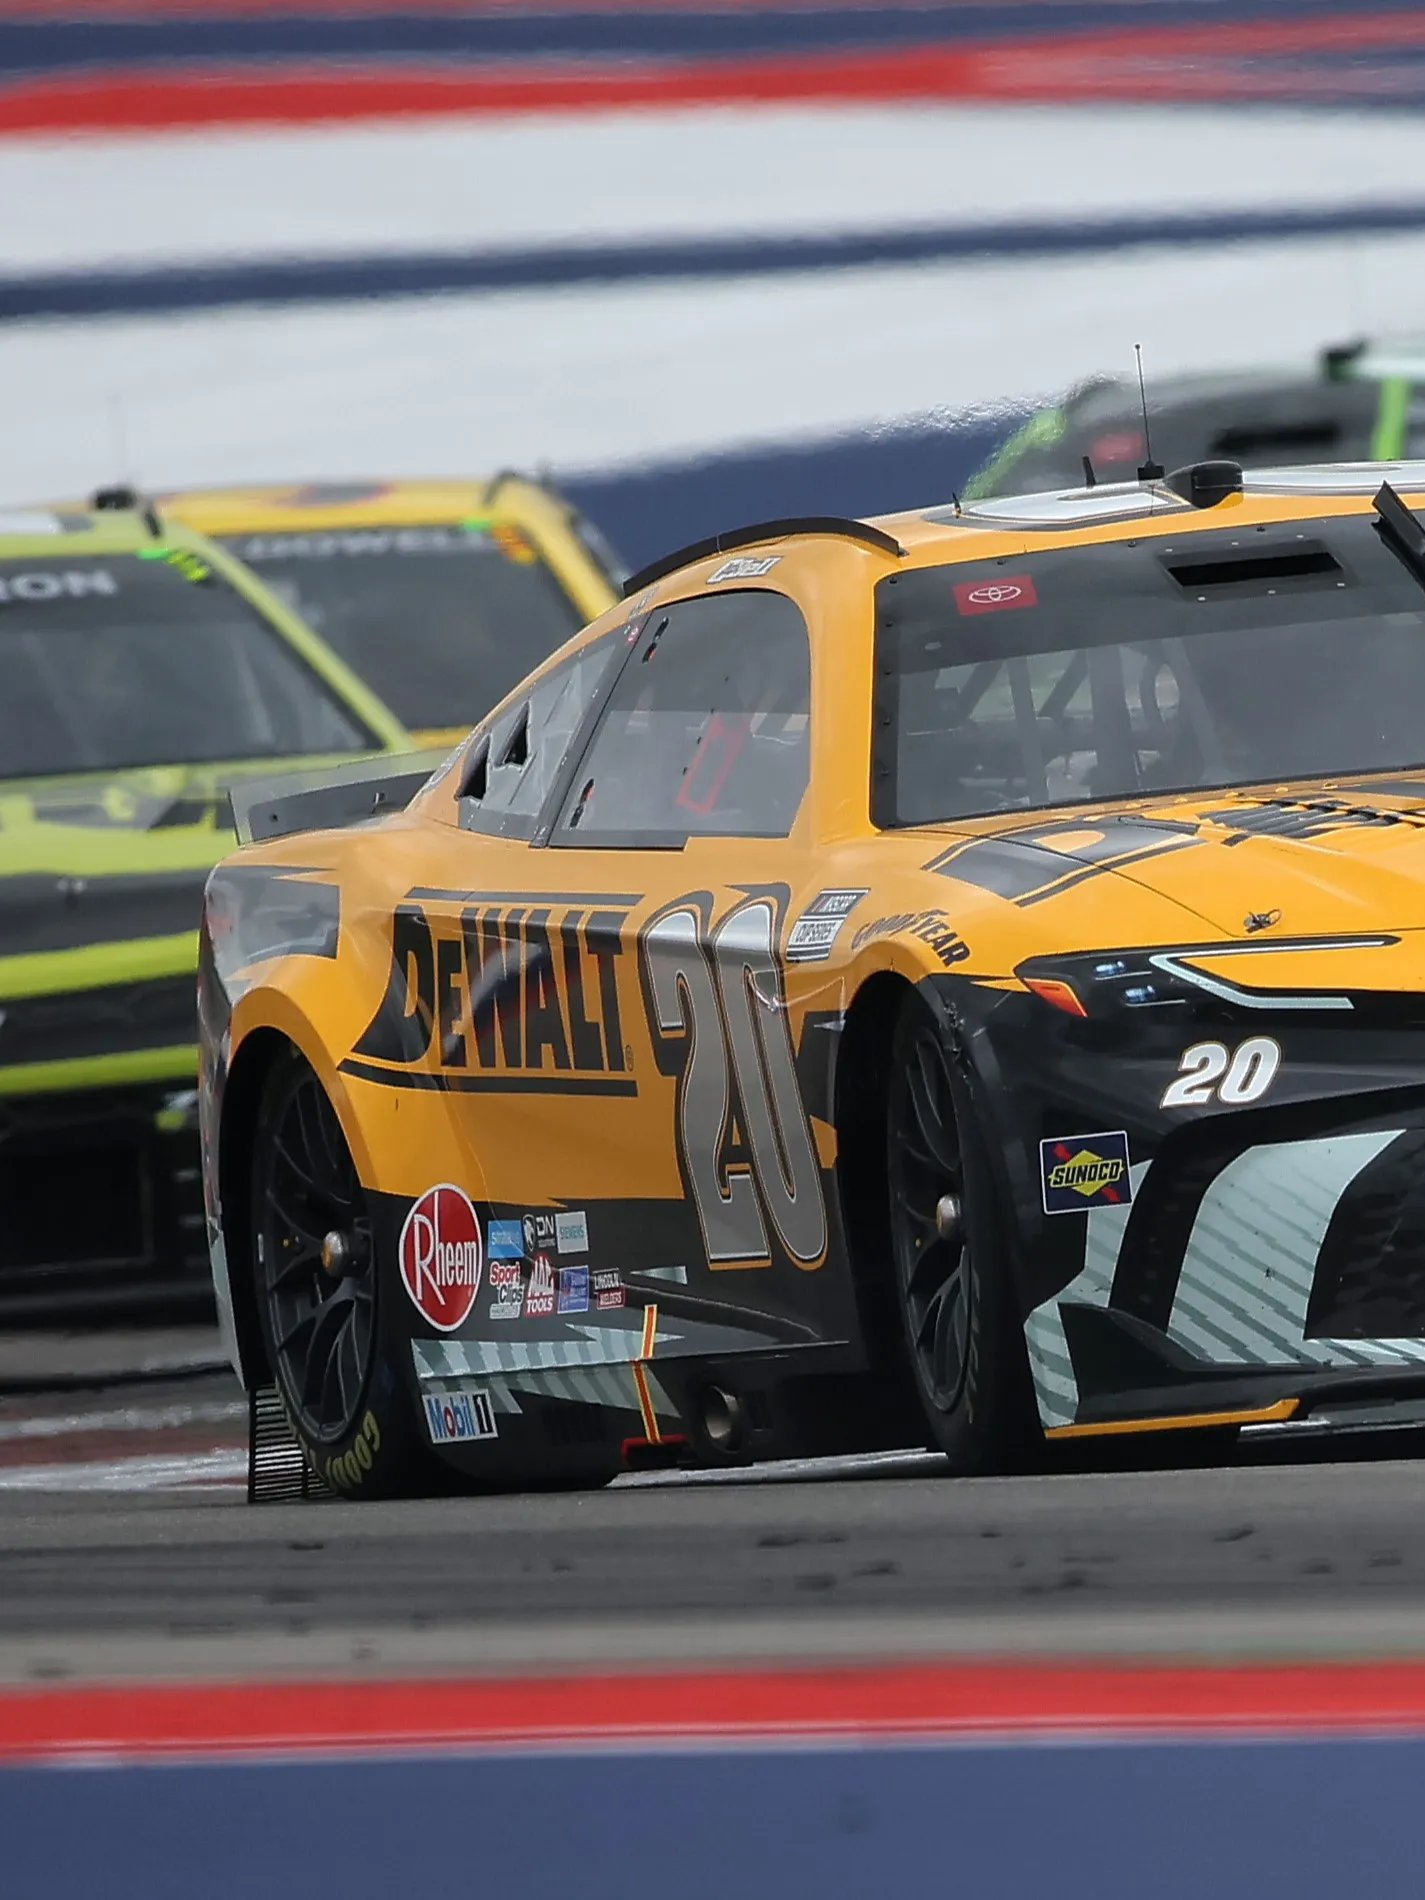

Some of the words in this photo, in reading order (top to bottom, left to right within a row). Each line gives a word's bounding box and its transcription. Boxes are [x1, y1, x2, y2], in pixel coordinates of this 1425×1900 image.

[640, 886, 828, 1269] 20
[1159, 1036, 1282, 1109] 20
[1052, 1160, 1122, 1187] SUNOCO
[413, 1191, 477, 1306] Rheem
[490, 1261, 520, 1286] Sport
[526, 1297, 554, 1314] TOOLS
[426, 1394, 476, 1438] Mobil
